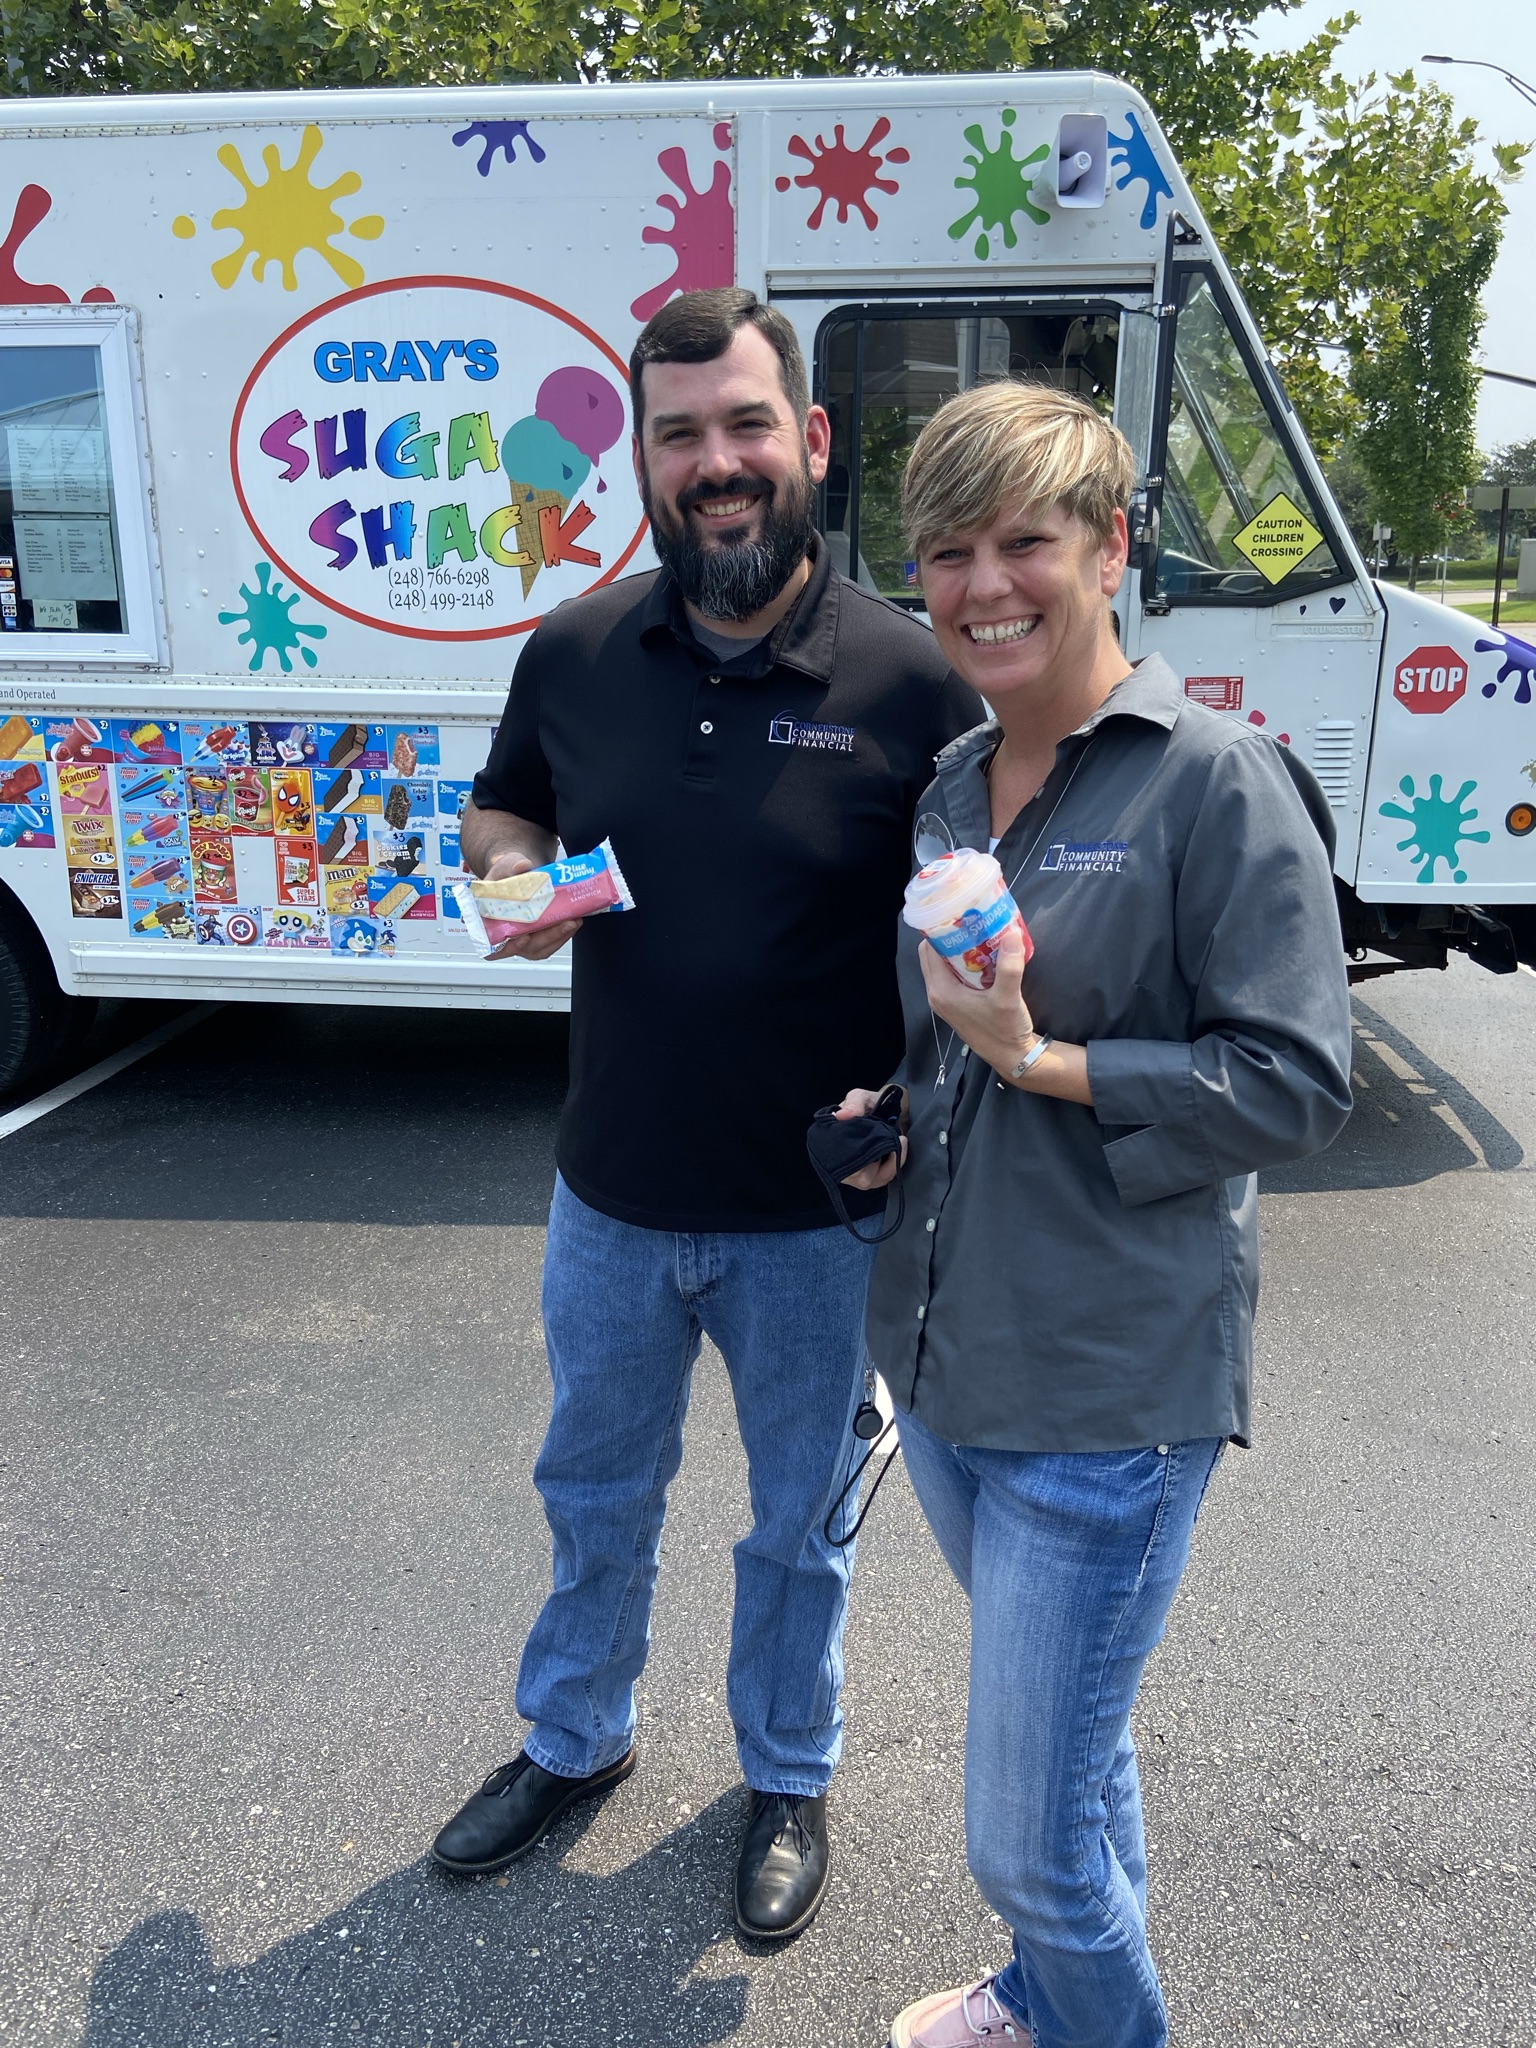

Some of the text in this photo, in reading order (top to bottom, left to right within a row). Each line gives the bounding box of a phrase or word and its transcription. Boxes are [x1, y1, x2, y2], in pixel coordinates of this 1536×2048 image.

[314, 339, 499, 383] GRAY'S
[260, 407, 500, 483] SUGA
[1256, 519, 1303, 530] CAUTION
[308, 499, 602, 571] SHACK
[1252, 533, 1304, 544] CHILDREN
[1251, 547, 1304, 557] CROSSING
[388, 567, 490, 589] (248) 766-6298
[388, 589, 494, 611] (248) 499-2148
[1399, 667, 1463, 694] STOP
[16, 688, 56, 701] Operated
[418, 726, 429, 735] $3
[794, 721, 855, 736] CORNERSTONE
[792, 729, 854, 743] COMMUNITY
[792, 738, 853, 752] FINANCIAL
[60, 768, 99, 785] Starburst
[73, 819, 104, 833] Twix
[393, 832, 406, 843] $3
[302, 842, 313, 851] $3
[376, 844, 408, 852] Cookies
[383, 849, 410, 858] Cream
[1062, 851, 1125, 862] COMMUNITY
[1059, 862, 1121, 872] FINANCIAL
[76, 873, 113, 884] SNICKERS
[570, 890, 601, 903] SANDWICH
[249, 907, 259, 916] $3
[317, 908, 326, 916] $3
[383, 919, 393, 928] $3
[969, 902, 1008, 936] SUNDAES
